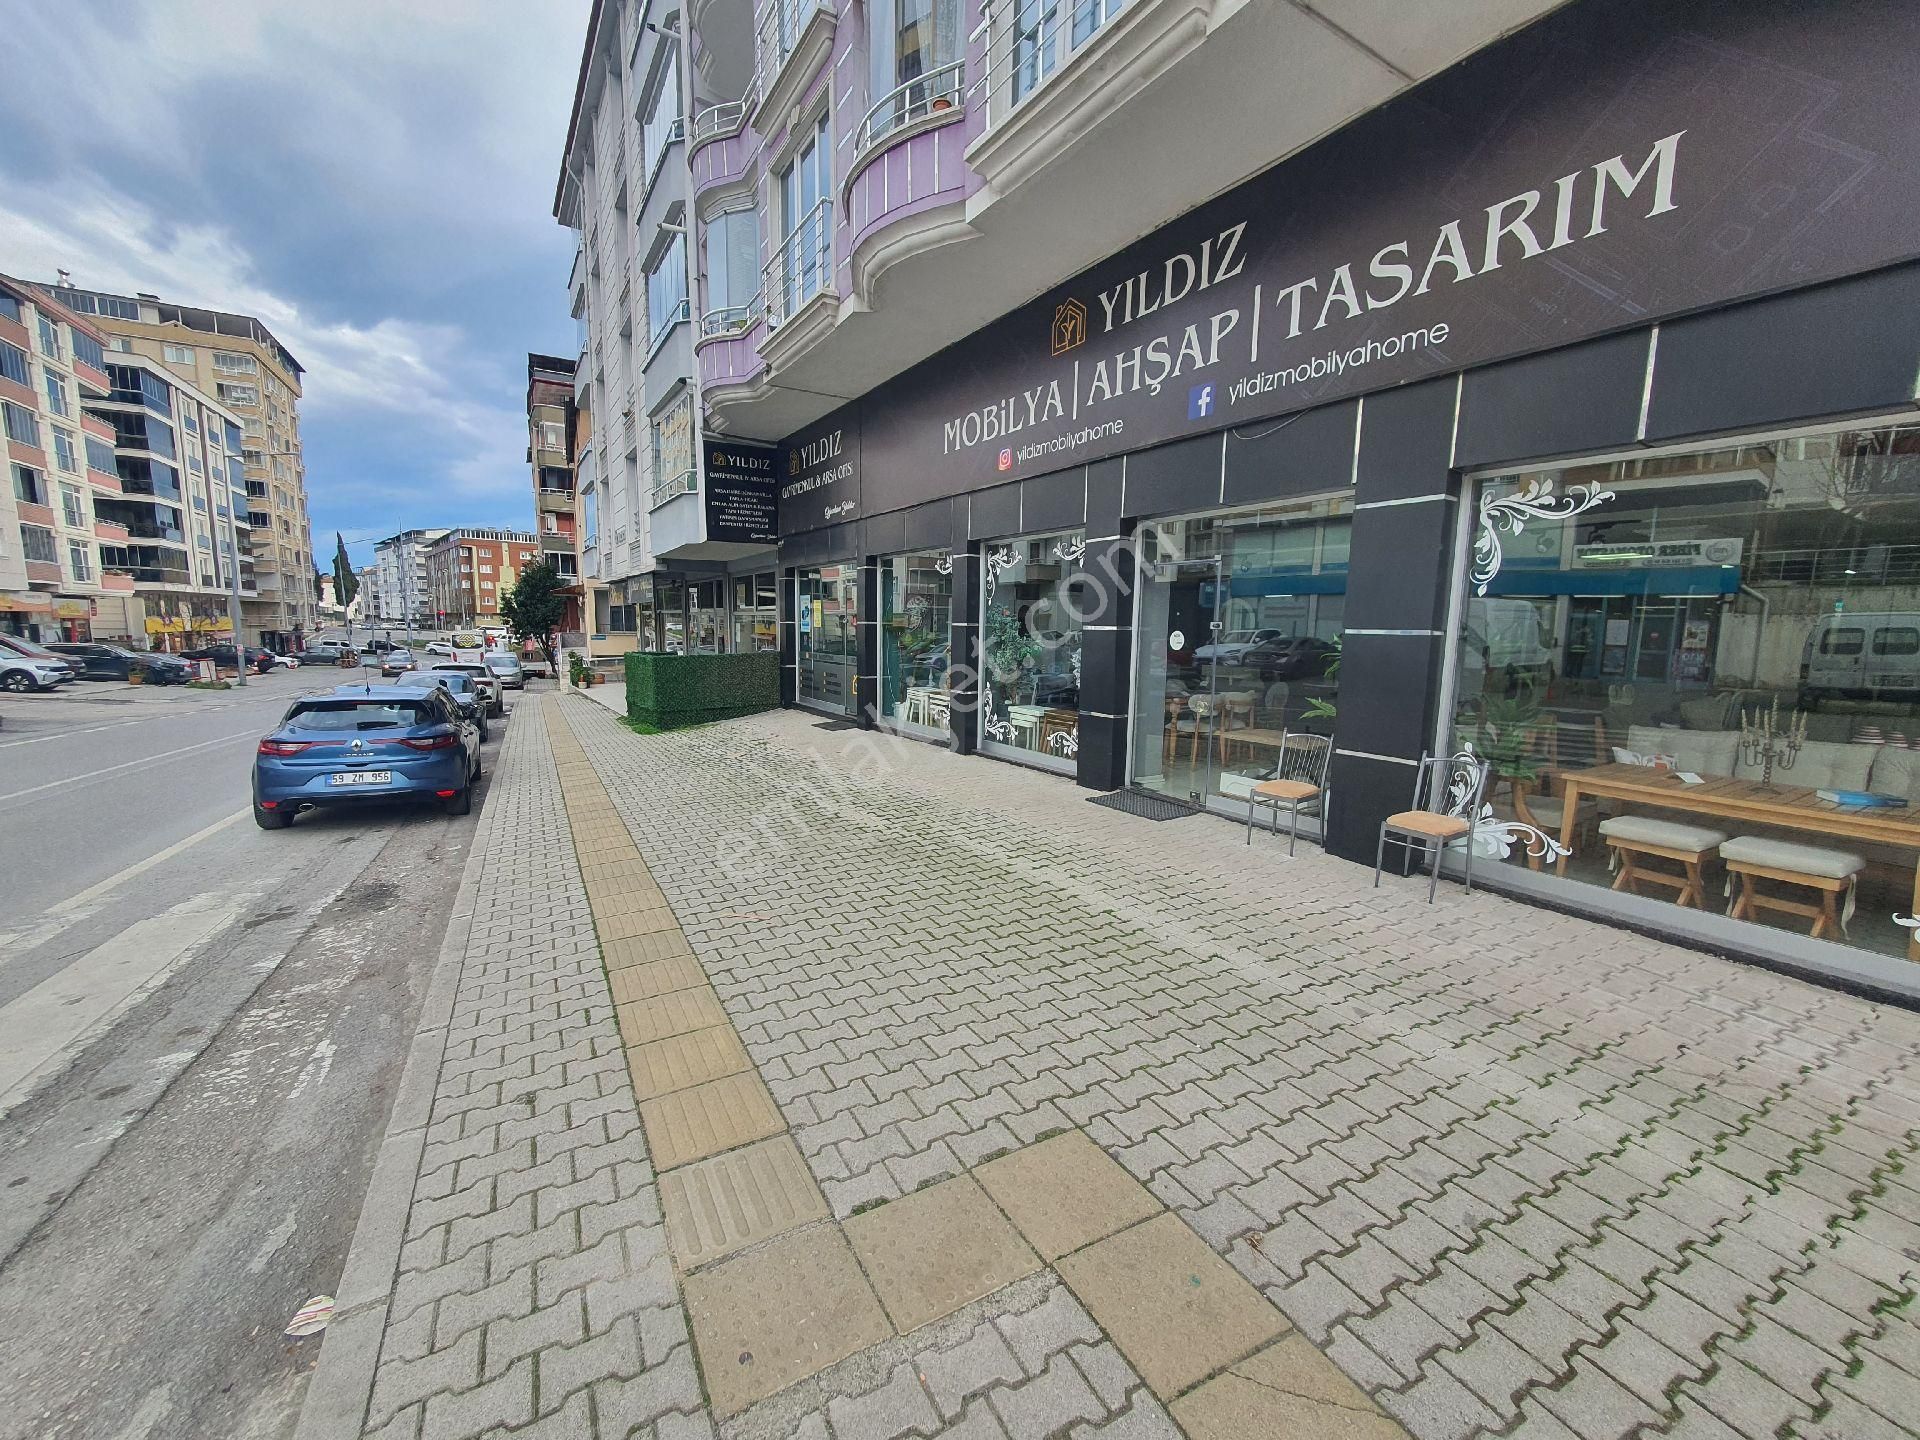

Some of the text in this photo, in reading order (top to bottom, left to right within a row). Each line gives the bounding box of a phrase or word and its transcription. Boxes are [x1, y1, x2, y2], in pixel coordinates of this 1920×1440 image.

[1086, 308, 1240, 407] AHŞAP
[1275, 129, 1688, 339] TASARIM
[1098, 221, 1248, 333] YILDIZ
[1228, 322, 1450, 405] yildizmobilyahome
[728, 455, 771, 470] YILDIZ
[801, 429, 843, 469] YILDIZ
[1017, 419, 1124, 465] yildizmobilyahome
[332, 772, 389, 783] 59 ZM 956
